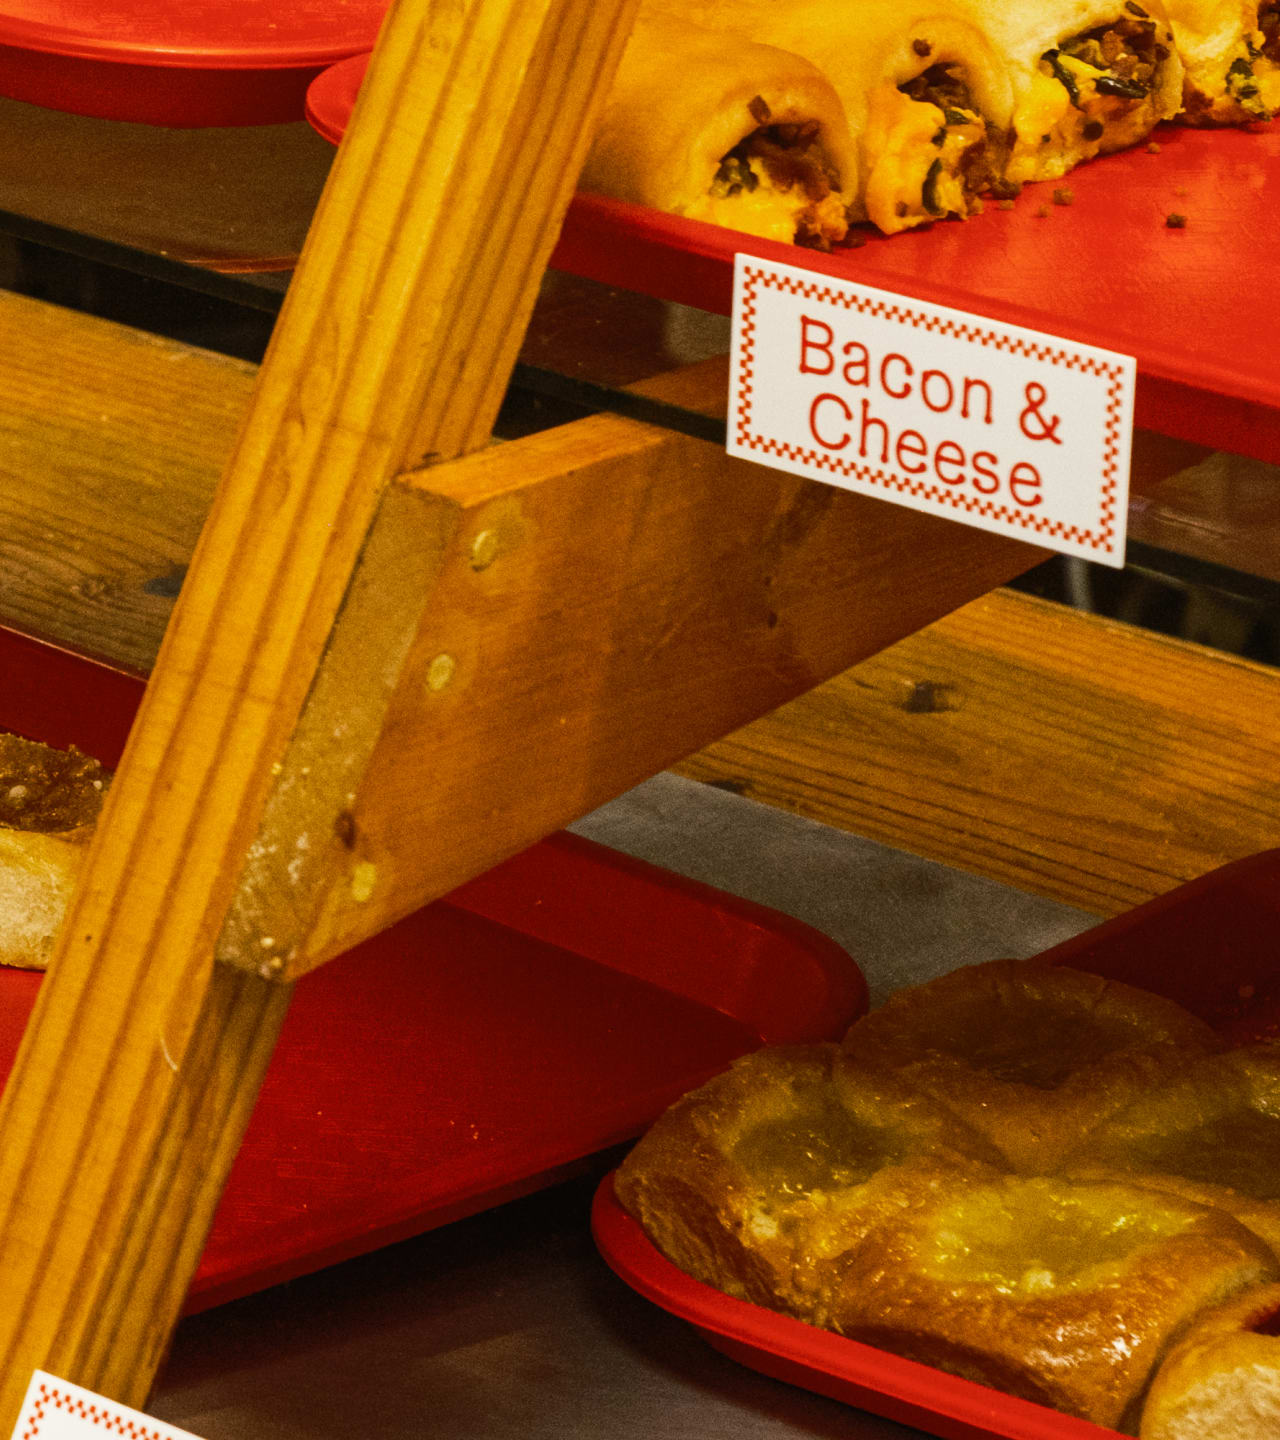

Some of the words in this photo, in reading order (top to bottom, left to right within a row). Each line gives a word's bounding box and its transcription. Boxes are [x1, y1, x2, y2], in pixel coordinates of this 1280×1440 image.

[798, 314, 994, 424] Bacon
[1018, 381, 1062, 445] &
[808, 392, 1043, 508] Cheese
